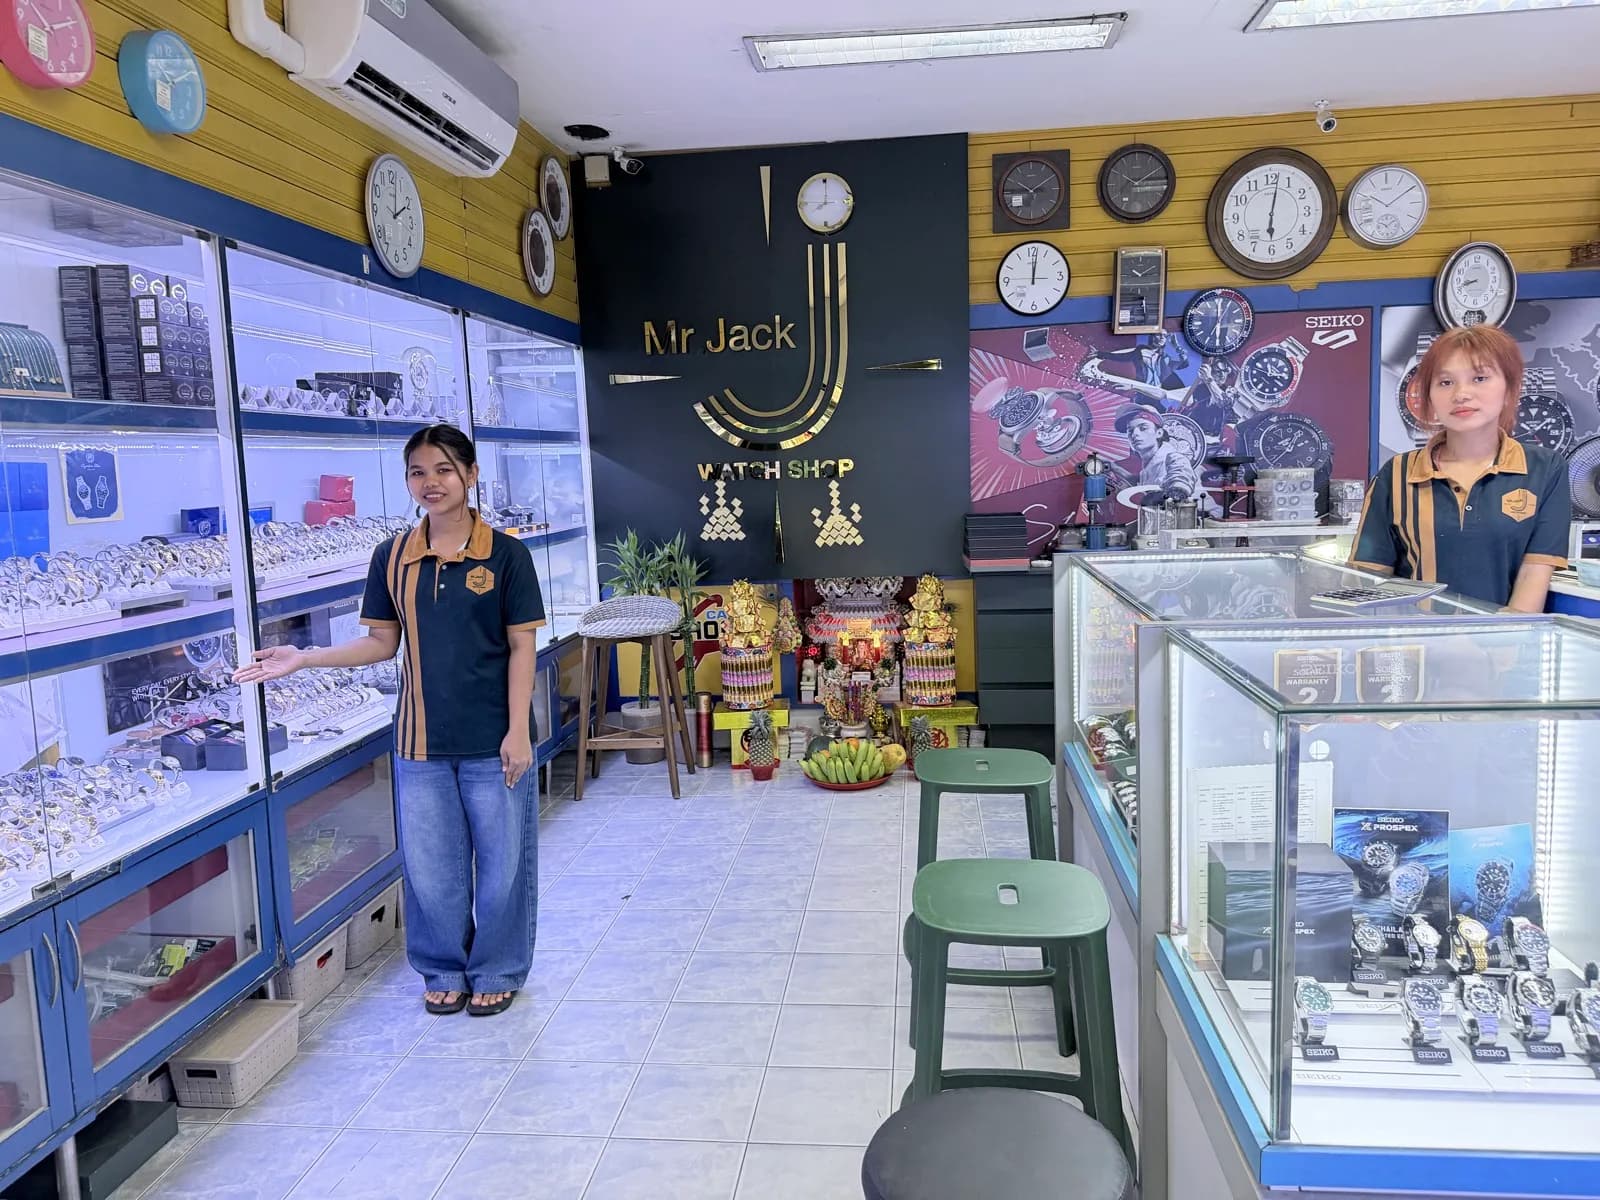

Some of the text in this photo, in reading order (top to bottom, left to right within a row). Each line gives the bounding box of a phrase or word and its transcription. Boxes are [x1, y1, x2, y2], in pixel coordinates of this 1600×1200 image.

[72, 36, 77, 48] 3
[69, 52, 75, 64] 4
[48, 60, 54, 72] 6
[60, 60, 66, 72] 5
[380, 171, 385, 186] 11
[388, 170, 394, 184] 12
[1264, 173, 1278, 186] 12
[1286, 177, 1291, 188] 1
[1246, 180, 1258, 192] 11
[1234, 194, 1248, 206] 10
[1298, 188, 1306, 200] 2
[406, 196, 411, 210] 2
[372, 203, 378, 217] 9
[1304, 206, 1311, 217] 3
[409, 216, 414, 230] 3
[1232, 212, 1240, 224] 9
[377, 224, 382, 240] 8
[1237, 230, 1245, 241] 8
[1298, 224, 1306, 236] 4
[408, 236, 412, 248] 4
[1250, 241, 1258, 252] 7
[1286, 238, 1294, 249] 5
[384, 242, 390, 255] 7
[402, 248, 408, 261] 5
[1028, 246, 1037, 257] 12
[1268, 244, 1276, 256] 6
[394, 250, 399, 264] 6
[1003, 276, 1010, 287] 9
[1056, 271, 1064, 282] 3
[1031, 301, 1038, 311] 6
[1305, 314, 1365, 328] SEIKO
[643, 314, 797, 355] Mr Jack
[697, 458, 855, 480] WATCH SHOP
[1373, 824, 1418, 832] PROSPEX
[1306, 1048, 1336, 1056] SEIKO
[1418, 1050, 1448, 1059] SEIKO
[1475, 1049, 1506, 1057] SEIKO
[1529, 1045, 1561, 1054] SEIKO
